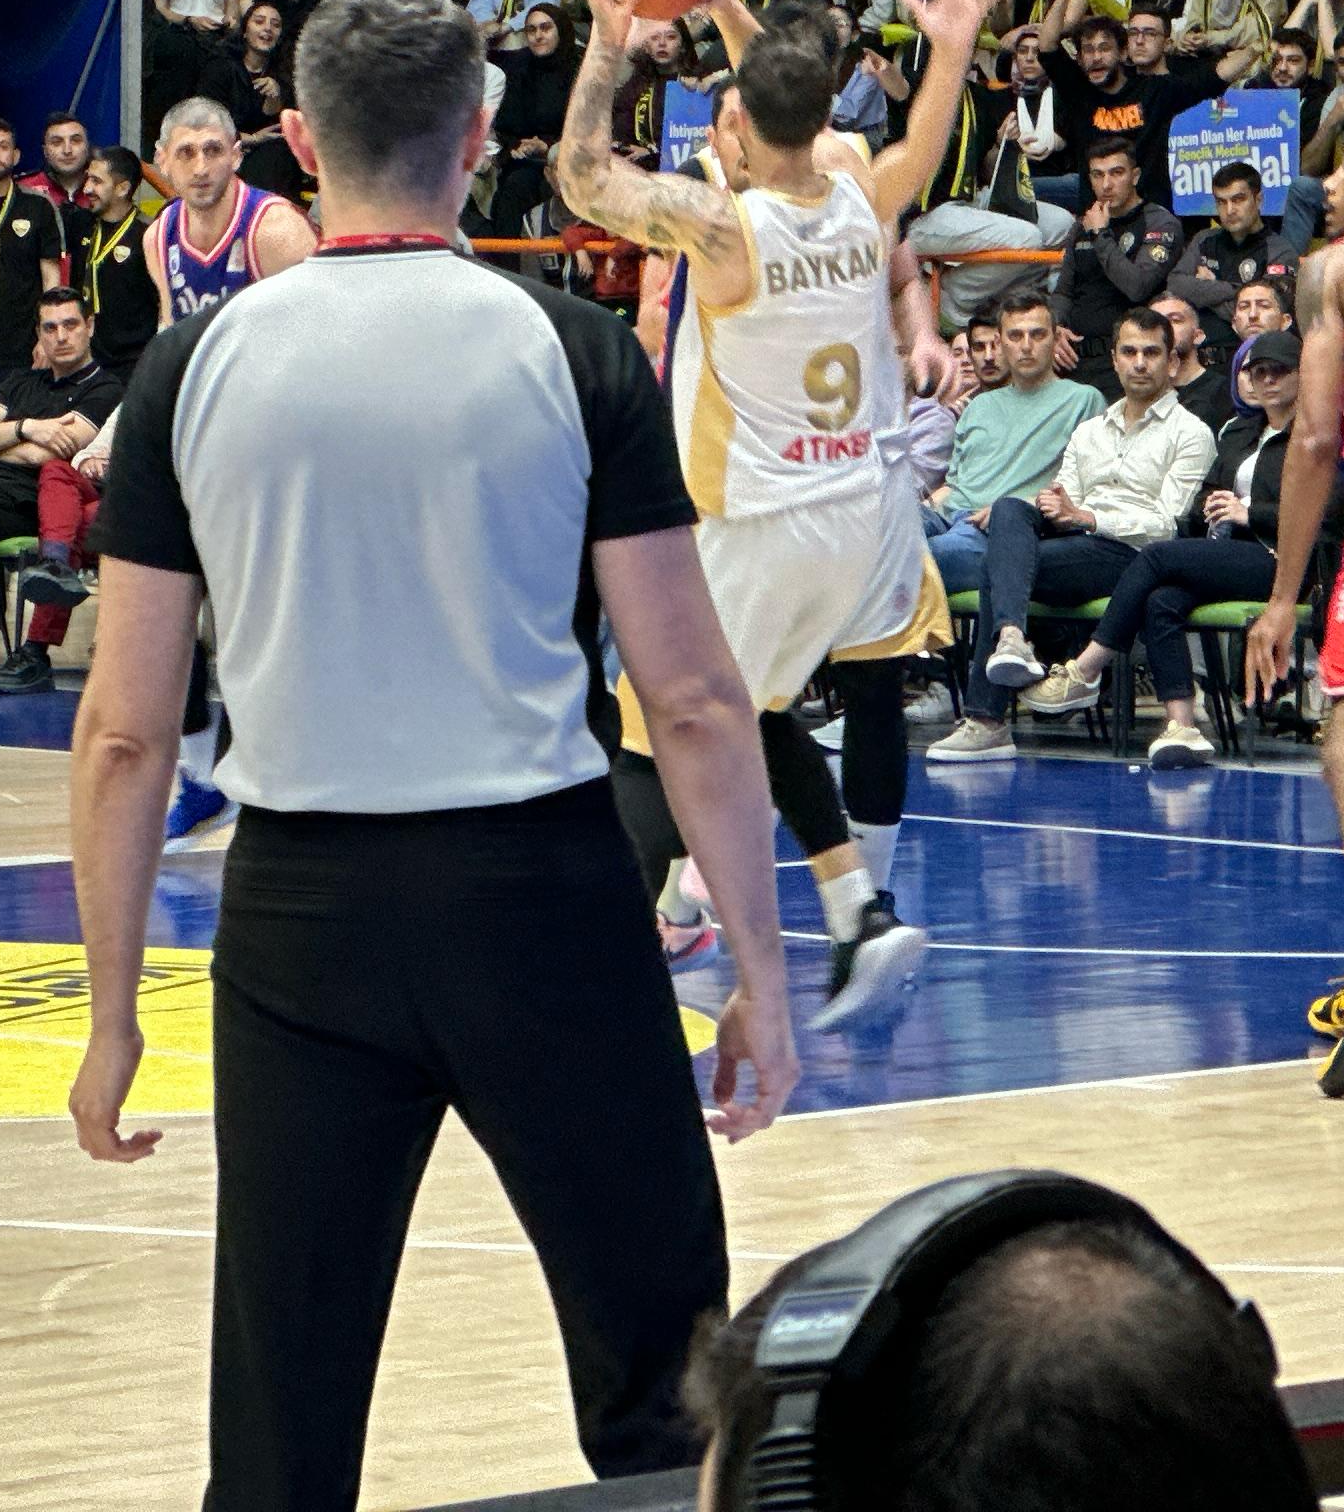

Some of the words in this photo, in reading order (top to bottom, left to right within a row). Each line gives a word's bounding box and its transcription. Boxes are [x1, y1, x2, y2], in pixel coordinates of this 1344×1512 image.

[1201, 129, 1224, 145] Olan
[1226, 126, 1245, 142] Her
[1247, 123, 1284, 141] Anında
[764, 240, 880, 296] BAYKAN
[802, 342, 861, 432] 9
